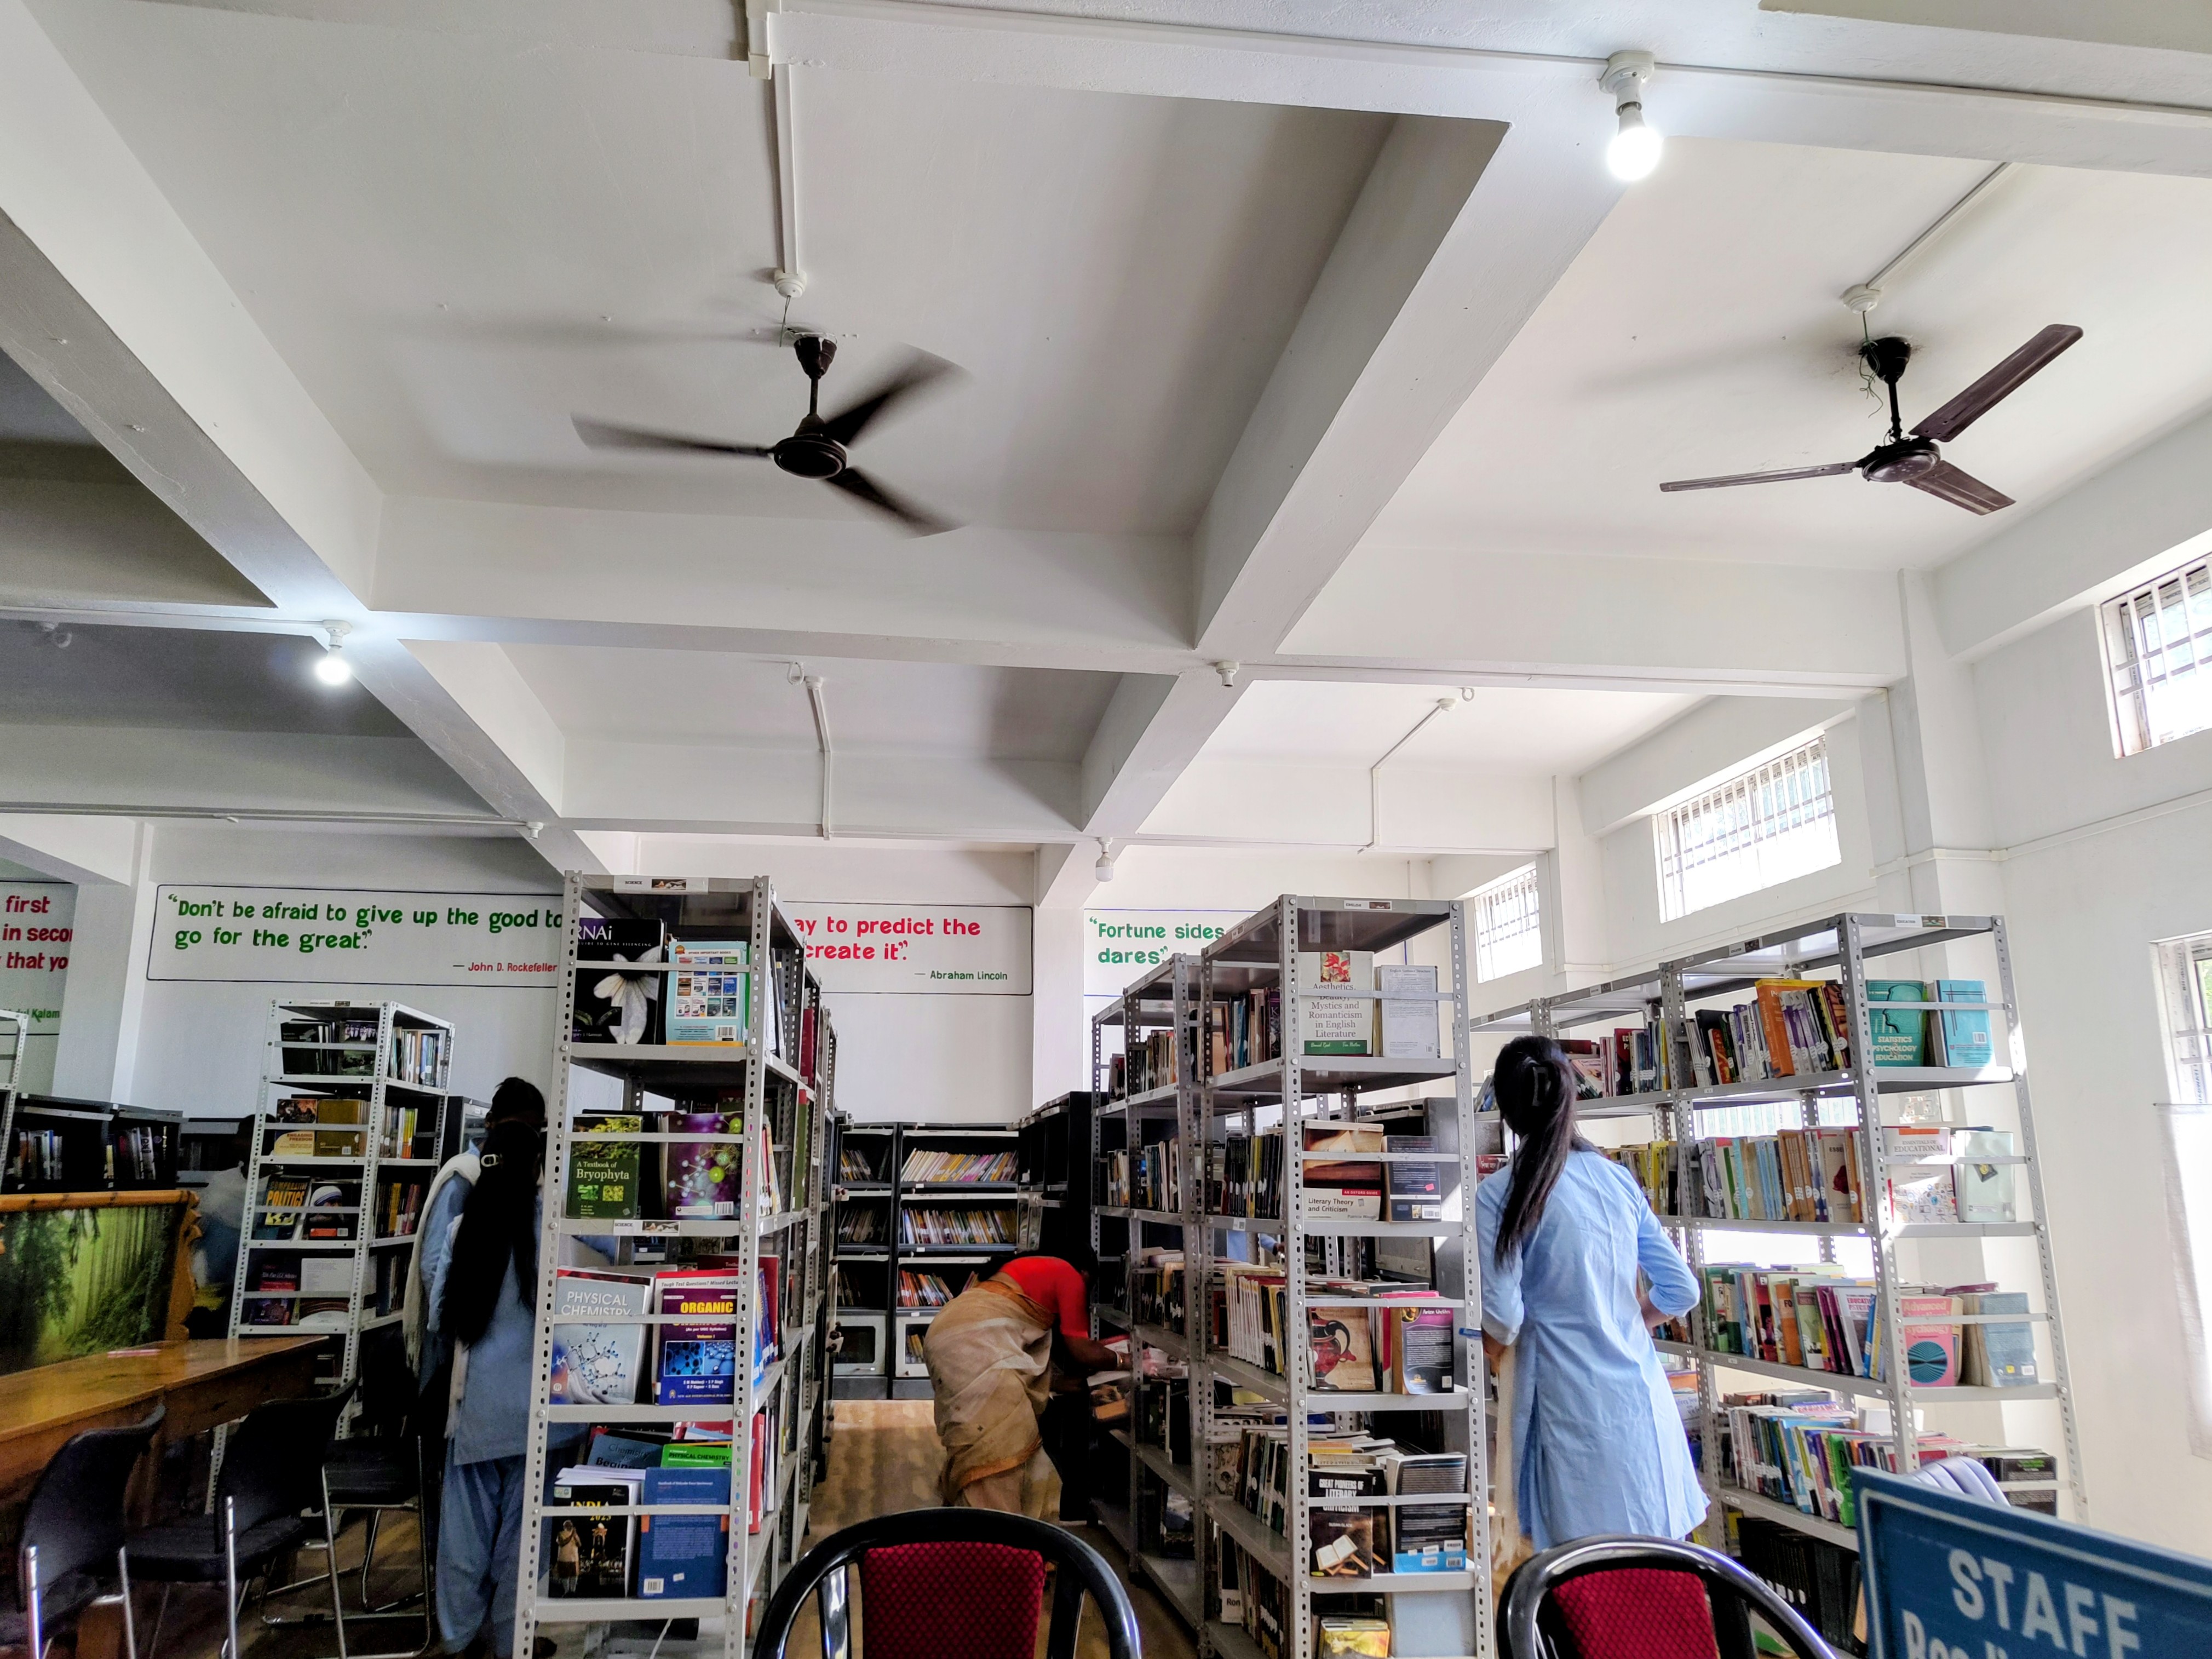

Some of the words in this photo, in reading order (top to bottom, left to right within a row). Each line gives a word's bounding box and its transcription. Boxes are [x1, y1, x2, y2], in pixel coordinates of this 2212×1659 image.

[6, 895, 50, 914] first
[233, 900, 255, 919] be
[262, 901, 318, 921] afraid
[326, 903, 347, 922] to
[355, 905, 403, 928] give
[413, 909, 438, 928] up
[446, 907, 479, 926] the
[489, 909, 538, 933] good
[545, 909, 563, 928] to
[2, 923, 21, 941] in
[27, 926, 72, 942] seco
[827, 915, 848, 933] to
[857, 917, 938, 937] predict
[943, 918, 981, 935] the
[1175, 922, 1225, 939] sides
[175, 929, 202, 950] go
[213, 926, 242, 945] for
[252, 928, 290, 947] the
[805, 943, 875, 961] create
[7, 952, 44, 969] that
[468, 961, 493, 972] John
[496, 962, 504, 972] D.
[507, 962, 558, 973] Rockefeller
[929, 970, 974, 980] Abraham
[977, 971, 1008, 980] Lincoln
[32, 1009, 60, 1023] Kalam
[1325, 1021, 1356, 1029] English
[1894, 1145, 1945, 1153] EDUCATIONAL
[576, 1168, 629, 1181] Bryophyta
[266, 1190, 305, 1206] POLITICS
[1332, 1198, 1354, 1206] Theory
[567, 1291, 628, 1306] PHYSICAL
[1904, 1300, 1946, 1311] Advanced
[680, 1301, 734, 1313] ORGANIC
[608, 1443, 651, 1461] Chemistry
[596, 1457, 634, 1469] Begin
[1319, 1478, 1334, 1488] GREAT
[1334, 1479, 1357, 1489] PIONEERS
[1358, 1480, 1364, 1490] OF
[1947, 1547, 2142, 1659] STAFF
